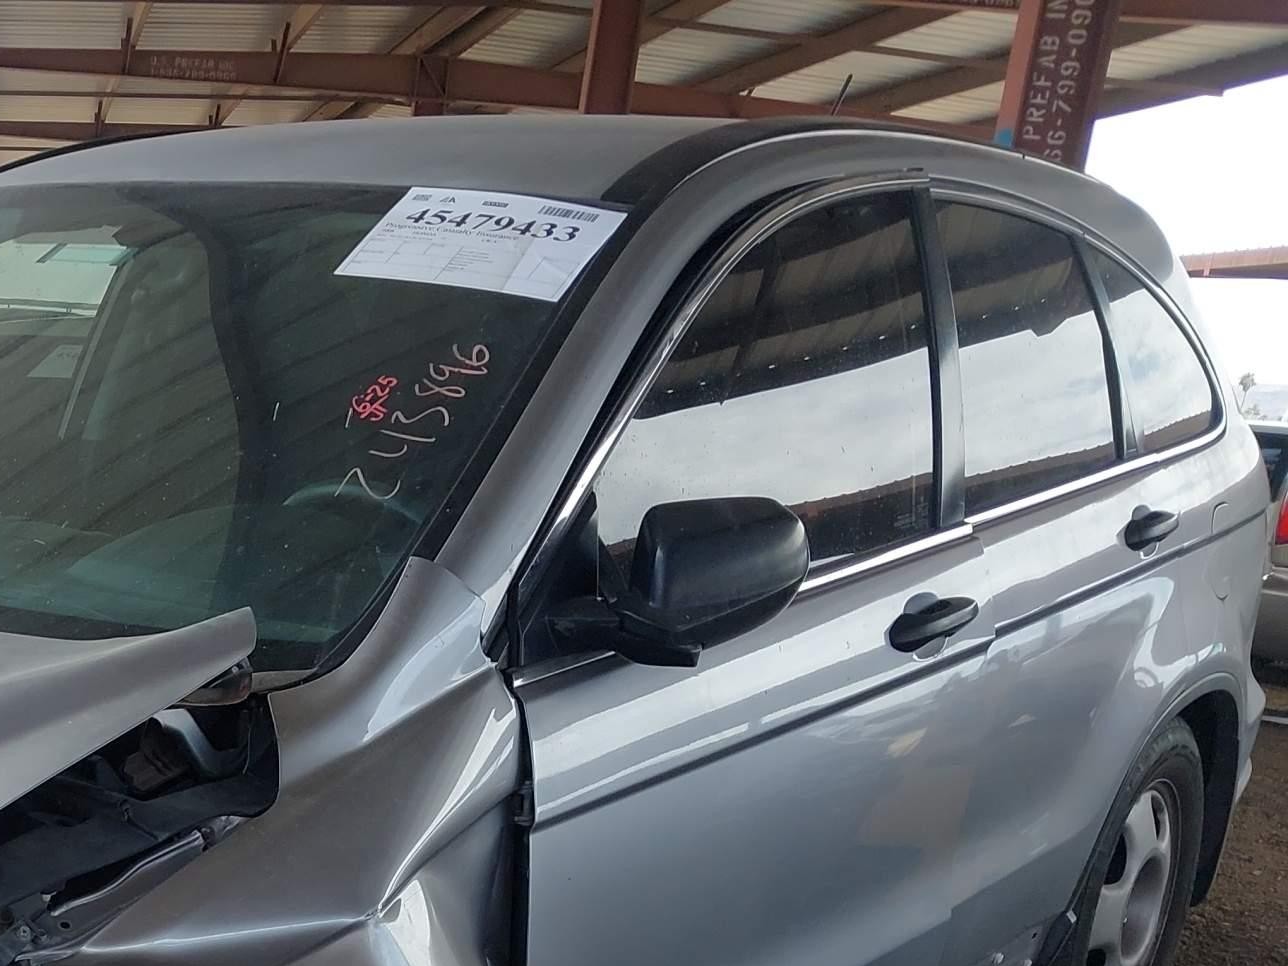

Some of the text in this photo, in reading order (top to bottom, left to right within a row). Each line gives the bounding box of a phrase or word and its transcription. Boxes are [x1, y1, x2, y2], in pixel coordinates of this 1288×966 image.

[1022, 35, 1060, 141] PREFAB
[385, 222, 436, 233] Progressive
[405, 207, 580, 242] 45479433
